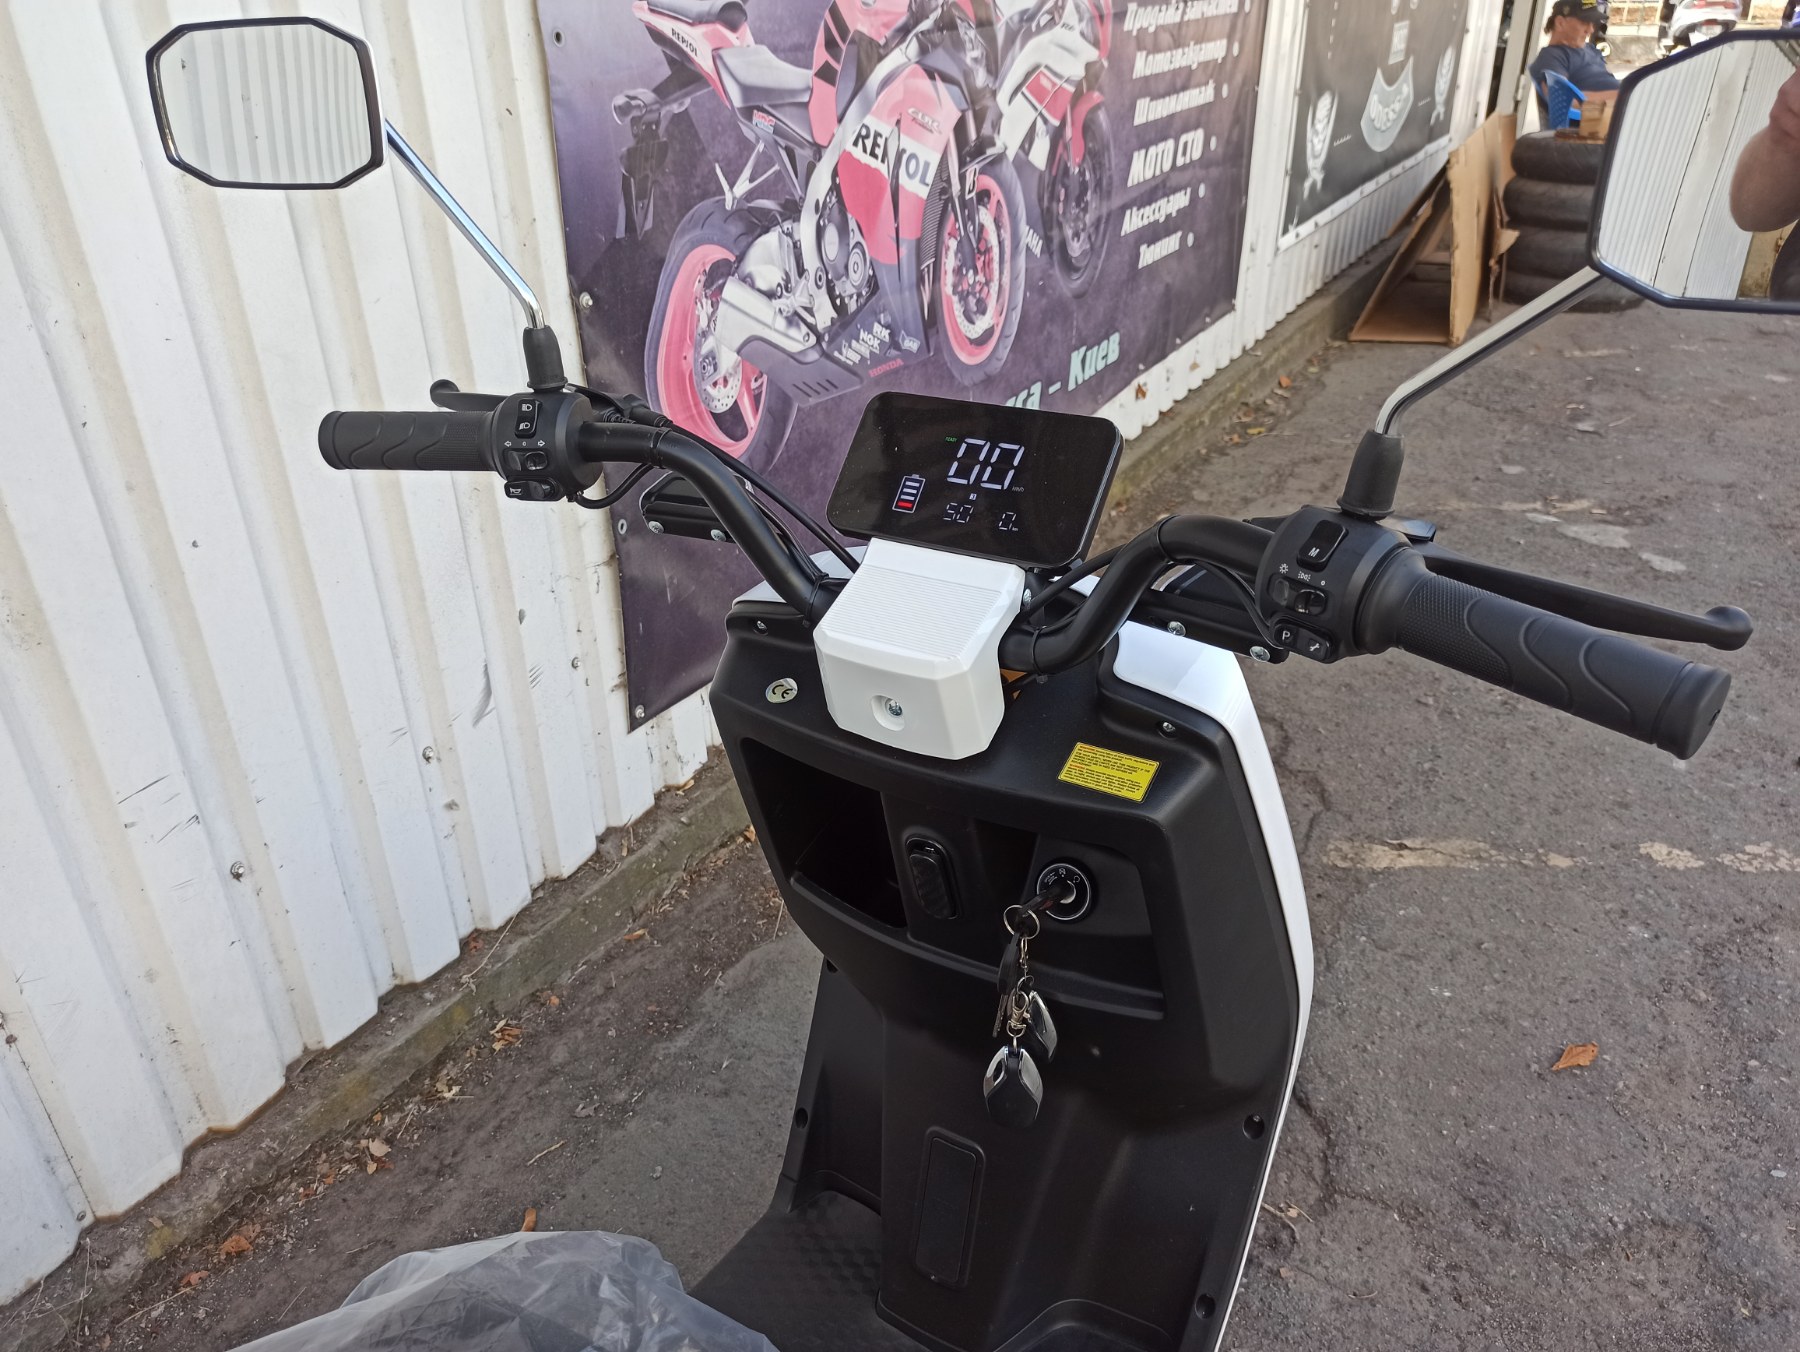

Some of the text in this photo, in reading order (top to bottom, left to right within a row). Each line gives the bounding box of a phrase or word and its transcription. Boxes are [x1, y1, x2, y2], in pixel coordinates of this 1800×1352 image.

[1124, 0, 1184, 36] Продажа
[1133, 38, 1227, 80] Мотоэвакуатор
[1134, 79, 1216, 126] Шиномонтаж
[1127, 127, 1204, 188] МОТО СТО
[1120, 187, 1192, 237] Аксессуары
[1138, 230, 1183, 270] Тюнинг
[860, 328, 880, 351] NGK
[868, 358, 905, 378] HONDA
[1068, 331, 1120, 392] Киев
[946, 437, 1025, 489] 00
[943, 502, 974, 523] 50
[999, 511, 1016, 530] 0
[1308, 547, 1320, 558] M
[1282, 630, 1291, 641] P
[771, 684, 794, 699] CE
